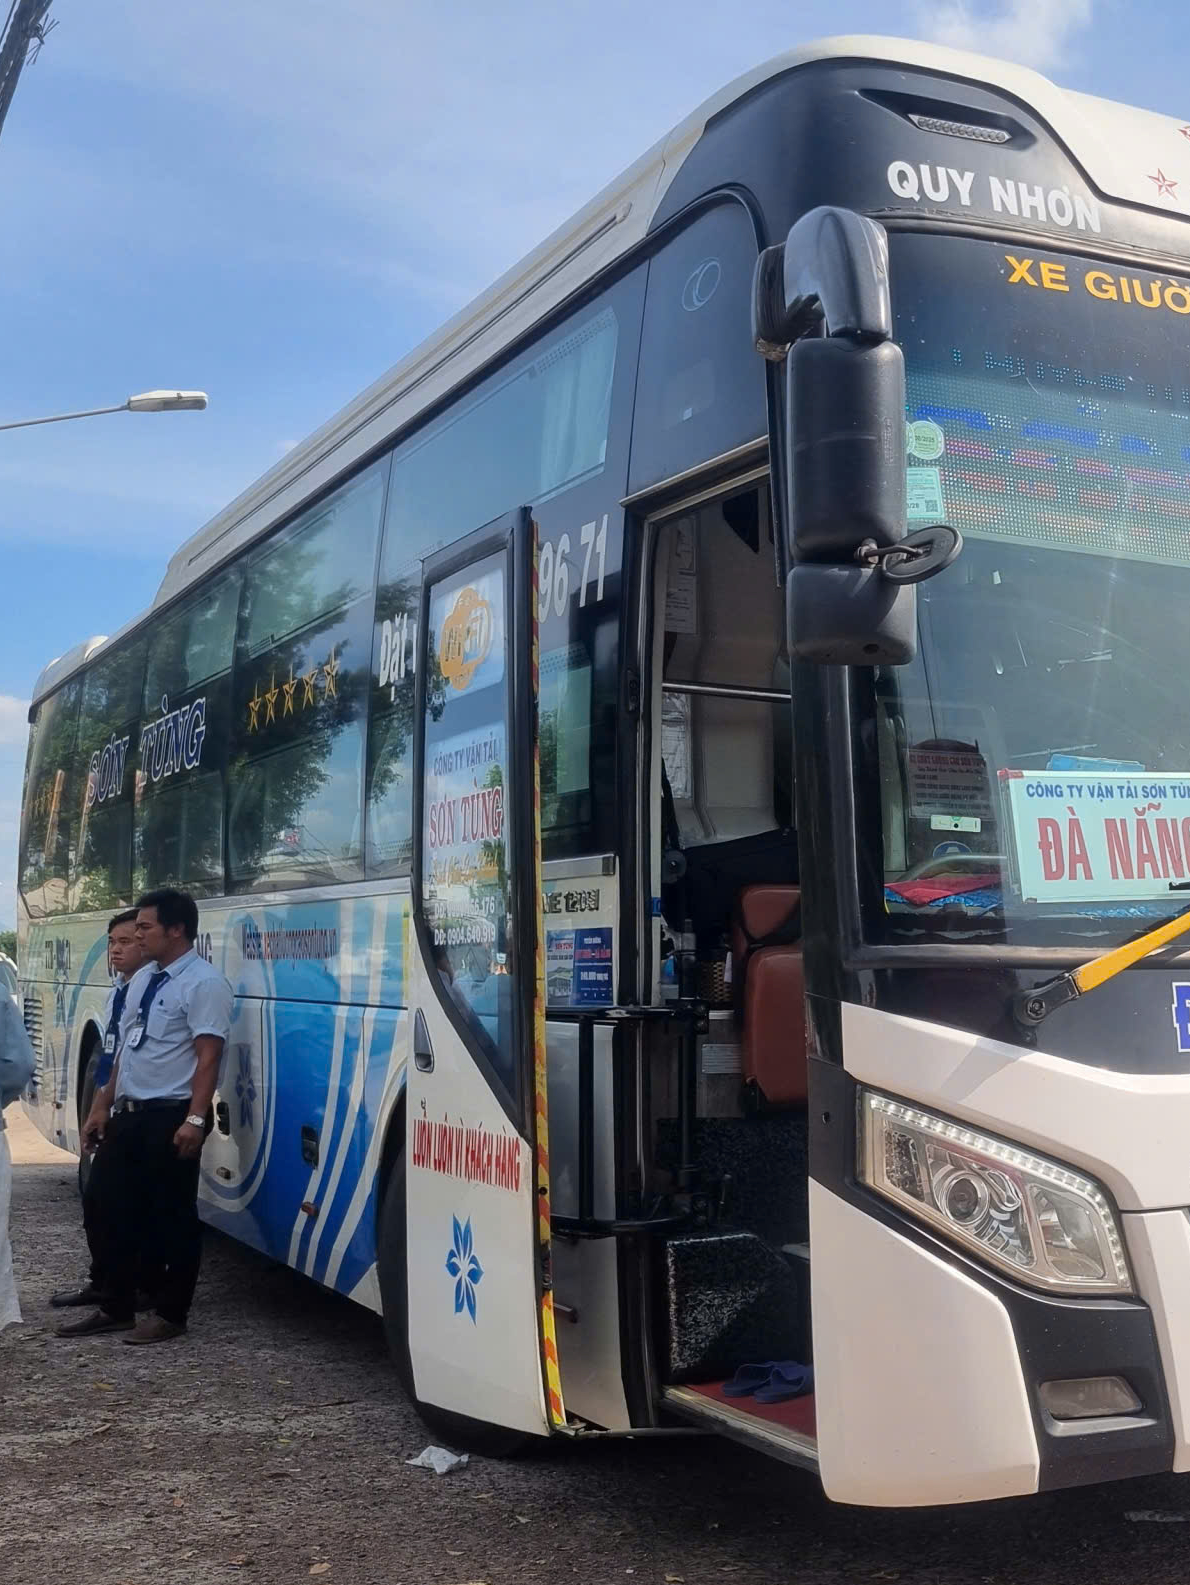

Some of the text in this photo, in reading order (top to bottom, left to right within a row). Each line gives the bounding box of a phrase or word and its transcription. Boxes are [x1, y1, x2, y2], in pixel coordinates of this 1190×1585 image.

[887, 160, 1101, 233] QUY NHƠN
[1005, 256, 1070, 292] XE
[579, 513, 609, 608] 71
[455, 747, 465, 771] TY
[1026, 781, 1063, 798] CÔNG
[1066, 783, 1084, 798] TY
[1087, 782, 1114, 802] VẬN
[1117, 780, 1138, 798] TẢI
[1141, 784, 1168, 799] SƠN
[1038, 806, 1094, 881] ĐÀ
